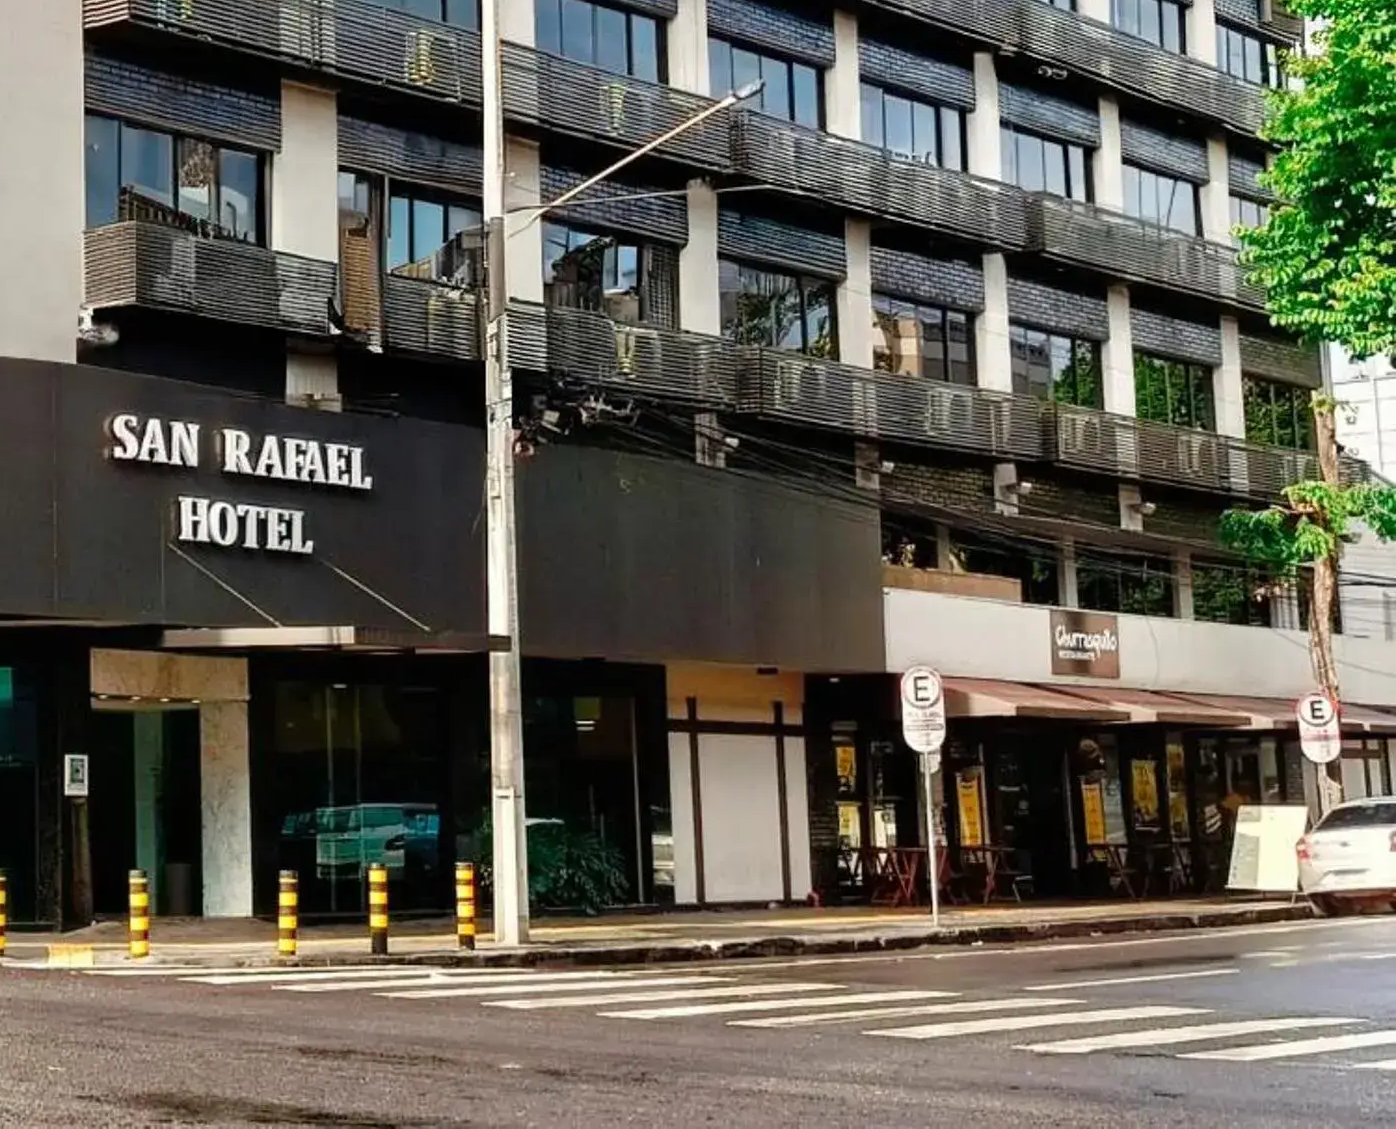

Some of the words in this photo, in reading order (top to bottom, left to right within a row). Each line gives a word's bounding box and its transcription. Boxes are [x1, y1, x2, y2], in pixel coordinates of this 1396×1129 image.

[112, 414, 200, 467] SAN
[221, 428, 373, 490] RAFAEL
[178, 495, 314, 554] HOTEL
[913, 675, 931, 702] E
[1309, 699, 1325, 720] E
